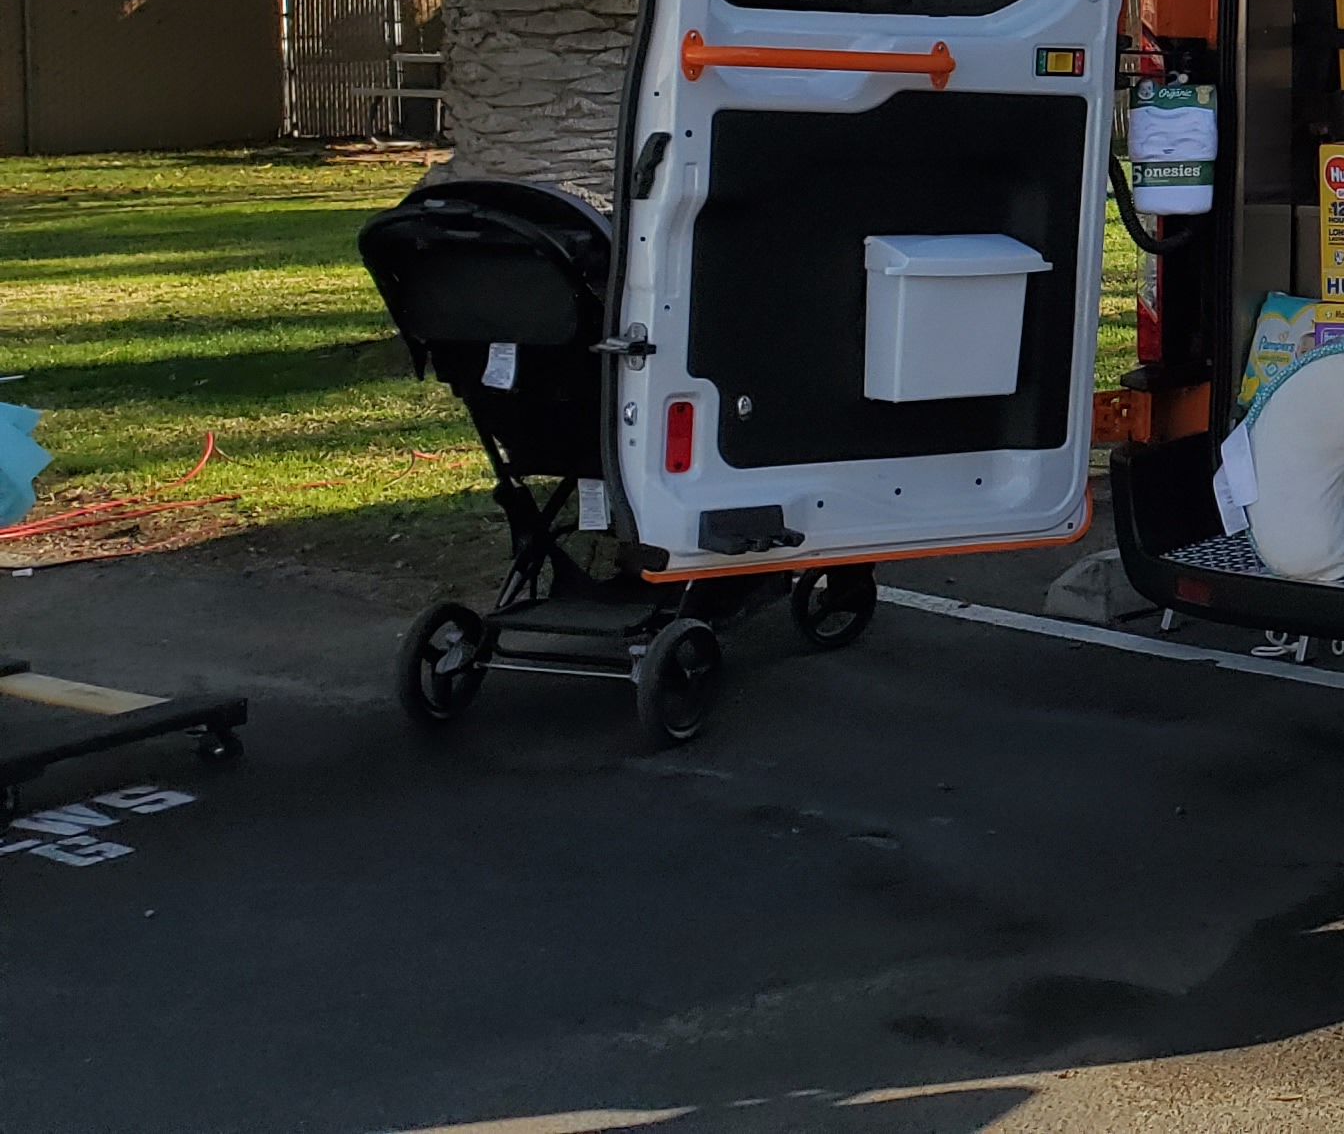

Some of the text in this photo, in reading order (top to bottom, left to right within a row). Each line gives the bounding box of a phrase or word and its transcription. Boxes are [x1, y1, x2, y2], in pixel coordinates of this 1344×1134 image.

[1158, 88, 1193, 100] Organic
[1132, 165, 1201, 184] 5 onesies
[0, 785, 198, 854] WS
